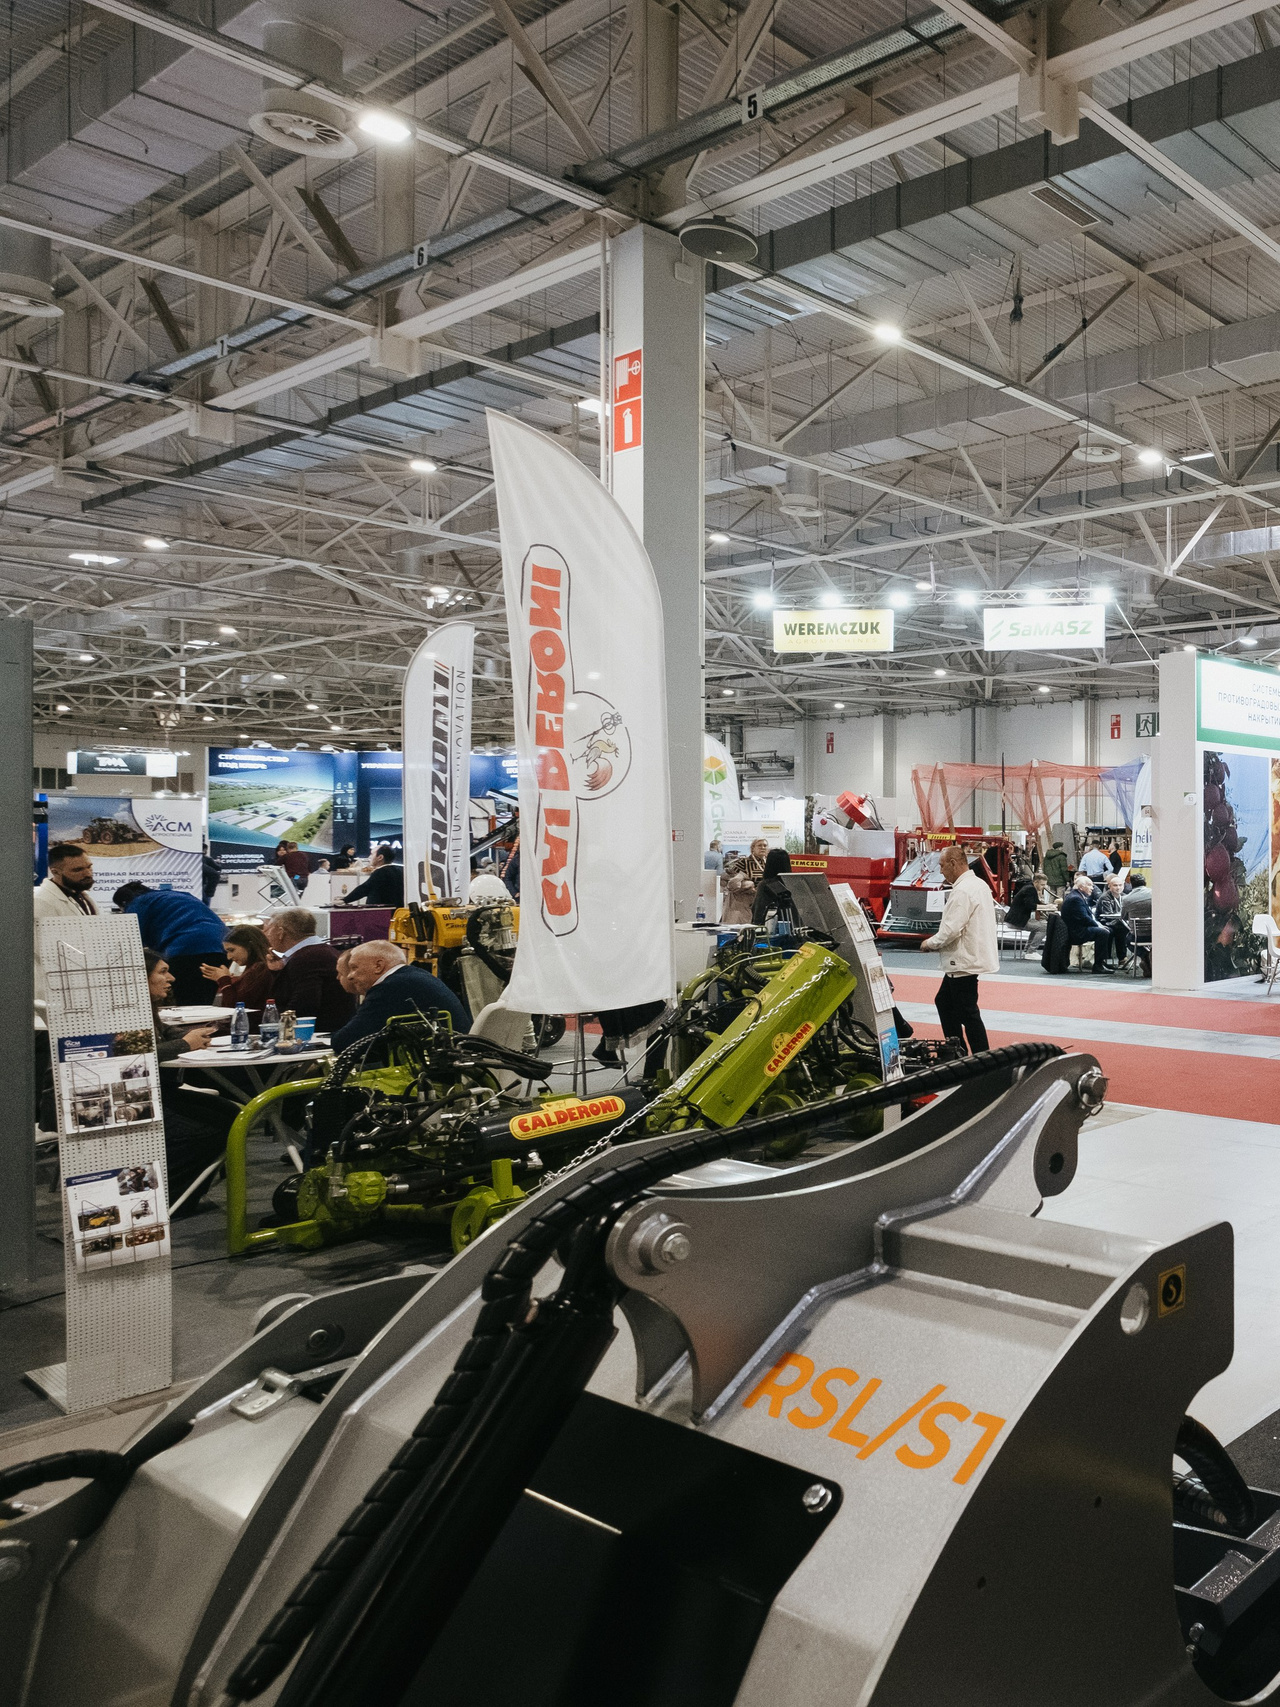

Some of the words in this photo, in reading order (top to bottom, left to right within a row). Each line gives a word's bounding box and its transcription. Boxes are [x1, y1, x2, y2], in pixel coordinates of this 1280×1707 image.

[747, 93, 758, 120] 5
[417, 246, 425, 267] 6
[784, 621, 881, 636] WEREMCZUK
[1008, 620, 1094, 637] SaMASZ
[767, 1023, 812, 1073] CALDERONI
[518, 1099, 619, 1133] CALDERONI
